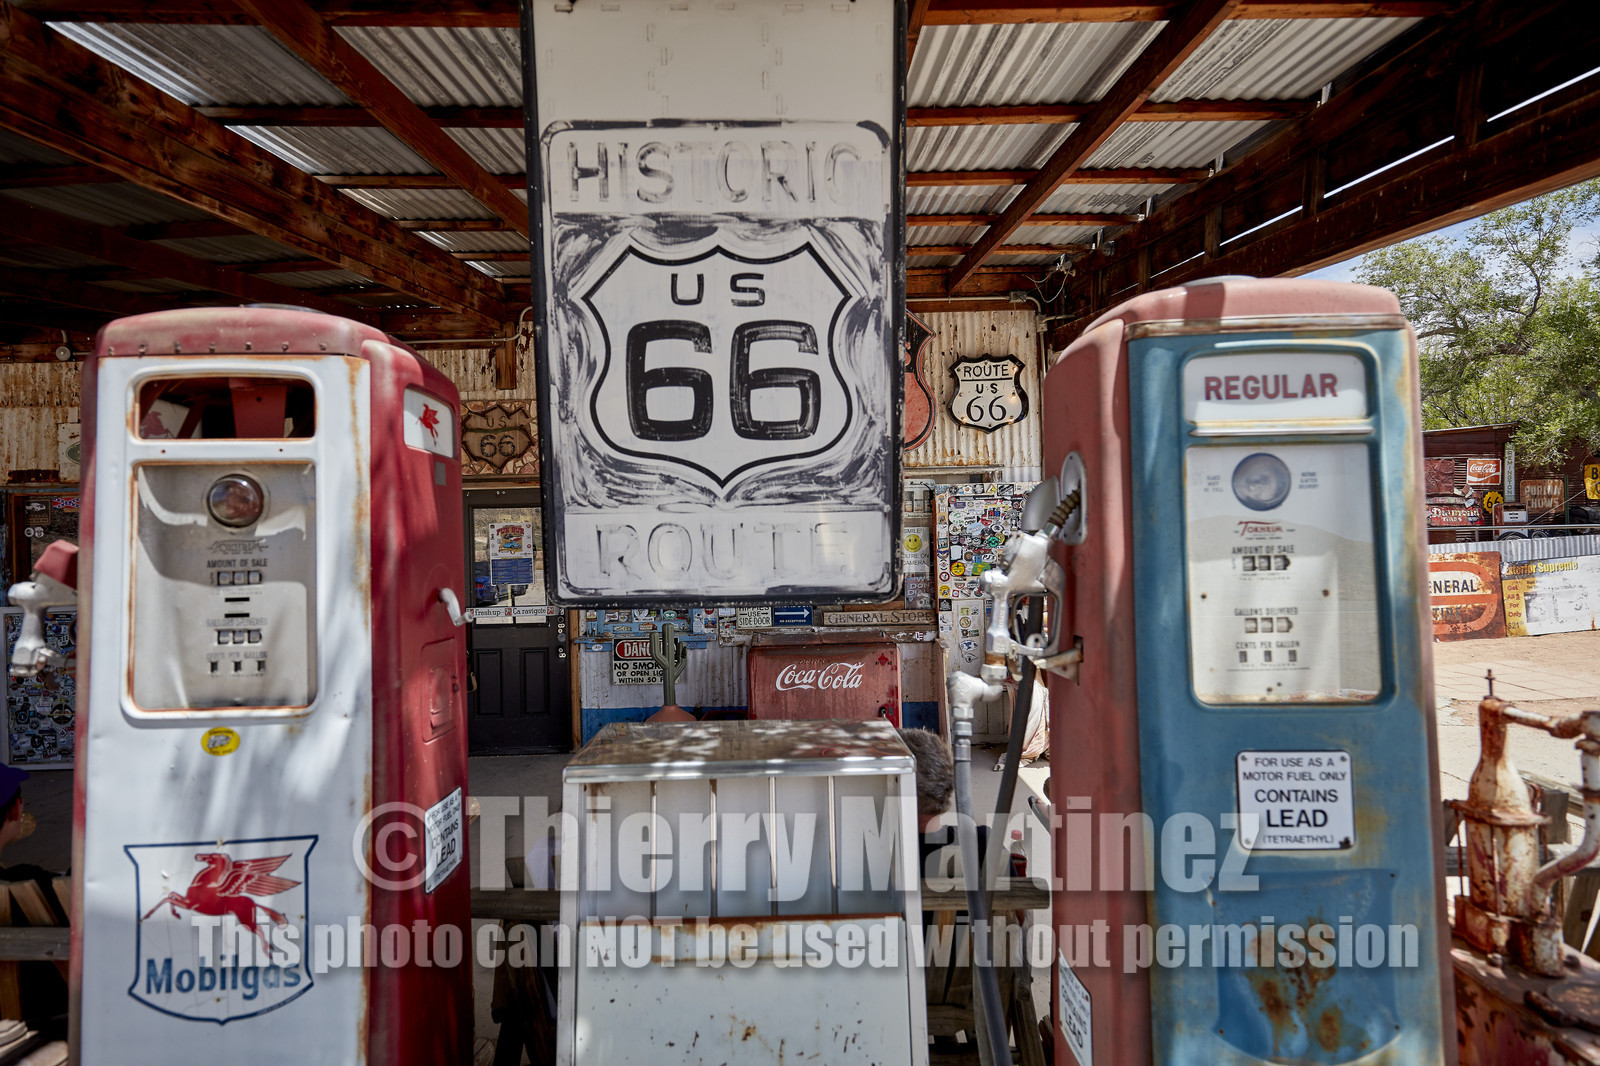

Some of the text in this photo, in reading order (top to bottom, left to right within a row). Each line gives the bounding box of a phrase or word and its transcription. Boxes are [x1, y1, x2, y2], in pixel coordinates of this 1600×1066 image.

[963, 364, 1010, 378] ROUTE
[626, 319, 821, 442] 66
[1204, 373, 1338, 400] REGULAR
[966, 394, 1006, 422] 66
[480, 434, 516, 457] 66
[1591, 467, 1600, 480] B
[1525, 484, 1560, 496] PURINA
[1527, 498, 1559, 509] CHOWS
[596, 522, 848, 581] ROUTE
[1232, 545, 1295, 554] AMOUNT OF SALE
[207, 558, 268, 568] AMOUNT OF SALE
[1537, 561, 1579, 573] Supreme
[1428, 579, 1478, 593] NERAL
[828, 613, 887, 624] GENERAL
[1432, 607, 1461, 620] TIRE
[754, 617, 770, 625] DOOR
[614, 662, 663, 670] NO SMOK
[776, 662, 865, 691] Coca-Cola
[1255, 757, 1335, 767] FOR USE AS A
[1243, 771, 1347, 781] MOTOR FUEL ONLY
[1254, 789, 1339, 803] CONTAINS
[1266, 809, 1329, 828] LEAD
[431, 819, 459, 850] CONTAINS
[1262, 835, 1334, 844] (TETRAETHYL)
[435, 837, 456, 867] LEAD
[146, 954, 301, 1001] Mobilgas
